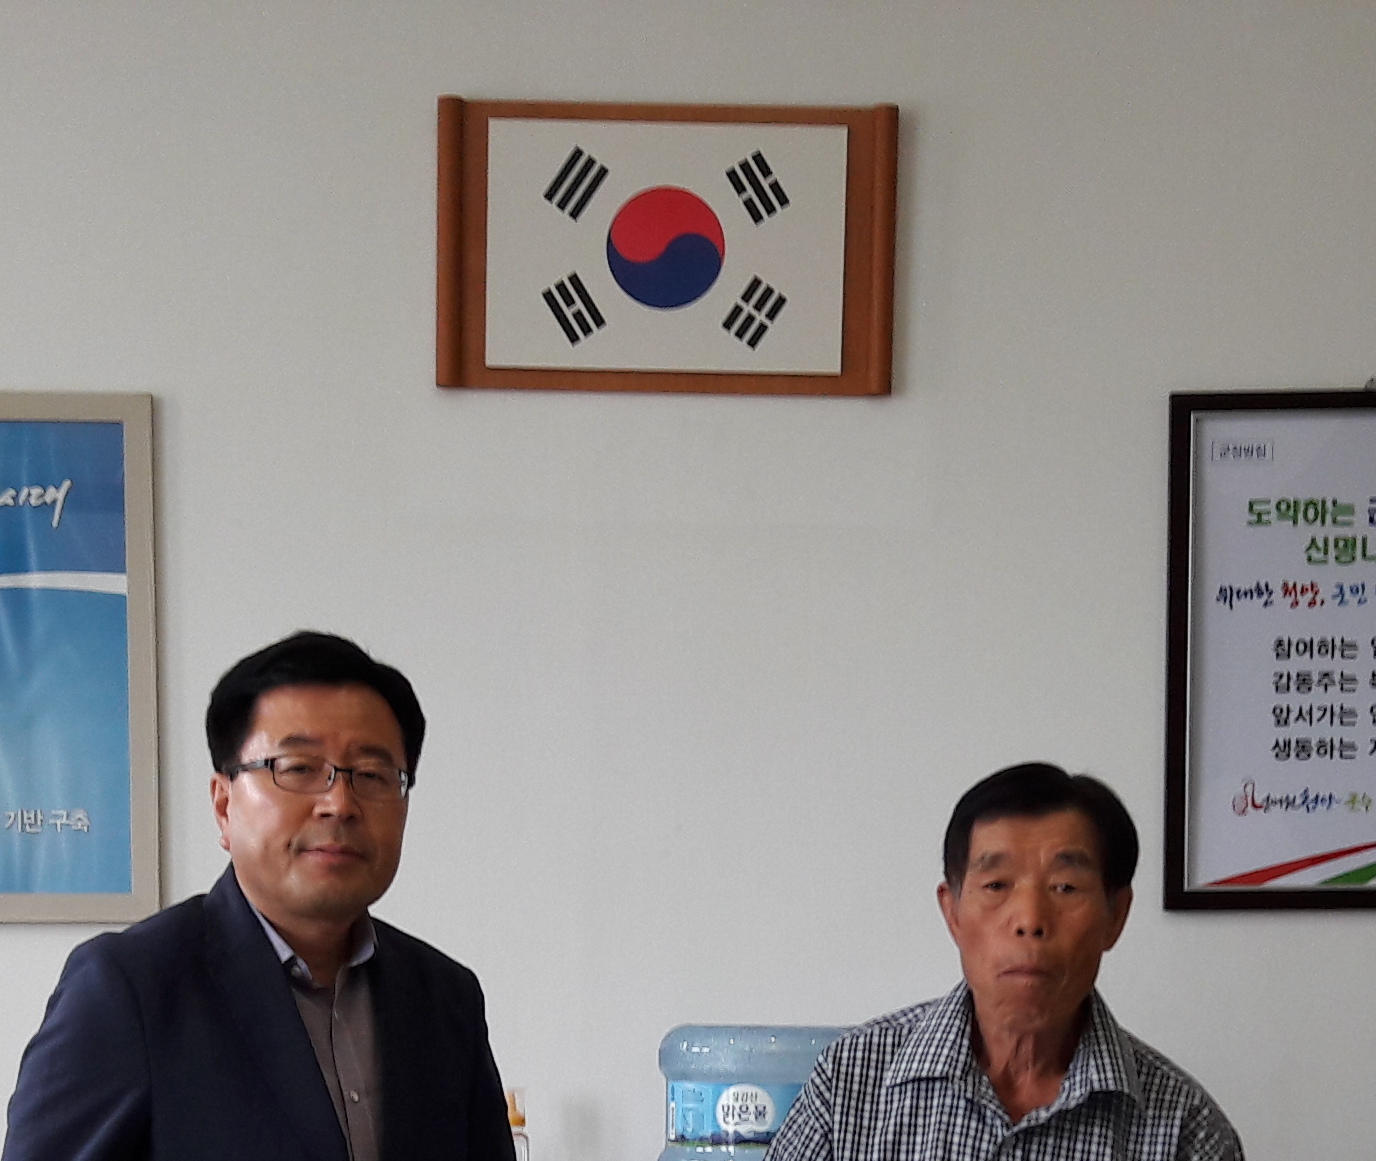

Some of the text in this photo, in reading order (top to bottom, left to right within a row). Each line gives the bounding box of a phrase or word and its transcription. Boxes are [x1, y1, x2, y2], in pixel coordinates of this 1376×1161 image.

[1247, 495, 1356, 527] 도약하는
[1281, 579, 1326, 609] 청양,
[1273, 635, 1359, 661] 참여하는
[1273, 669, 1359, 694] 감동주는
[1272, 703, 1359, 728] 앞서가는
[1271, 736, 1359, 762] 생동하는
[5, 809, 43, 833] 기반
[49, 809, 90, 833] 구축
